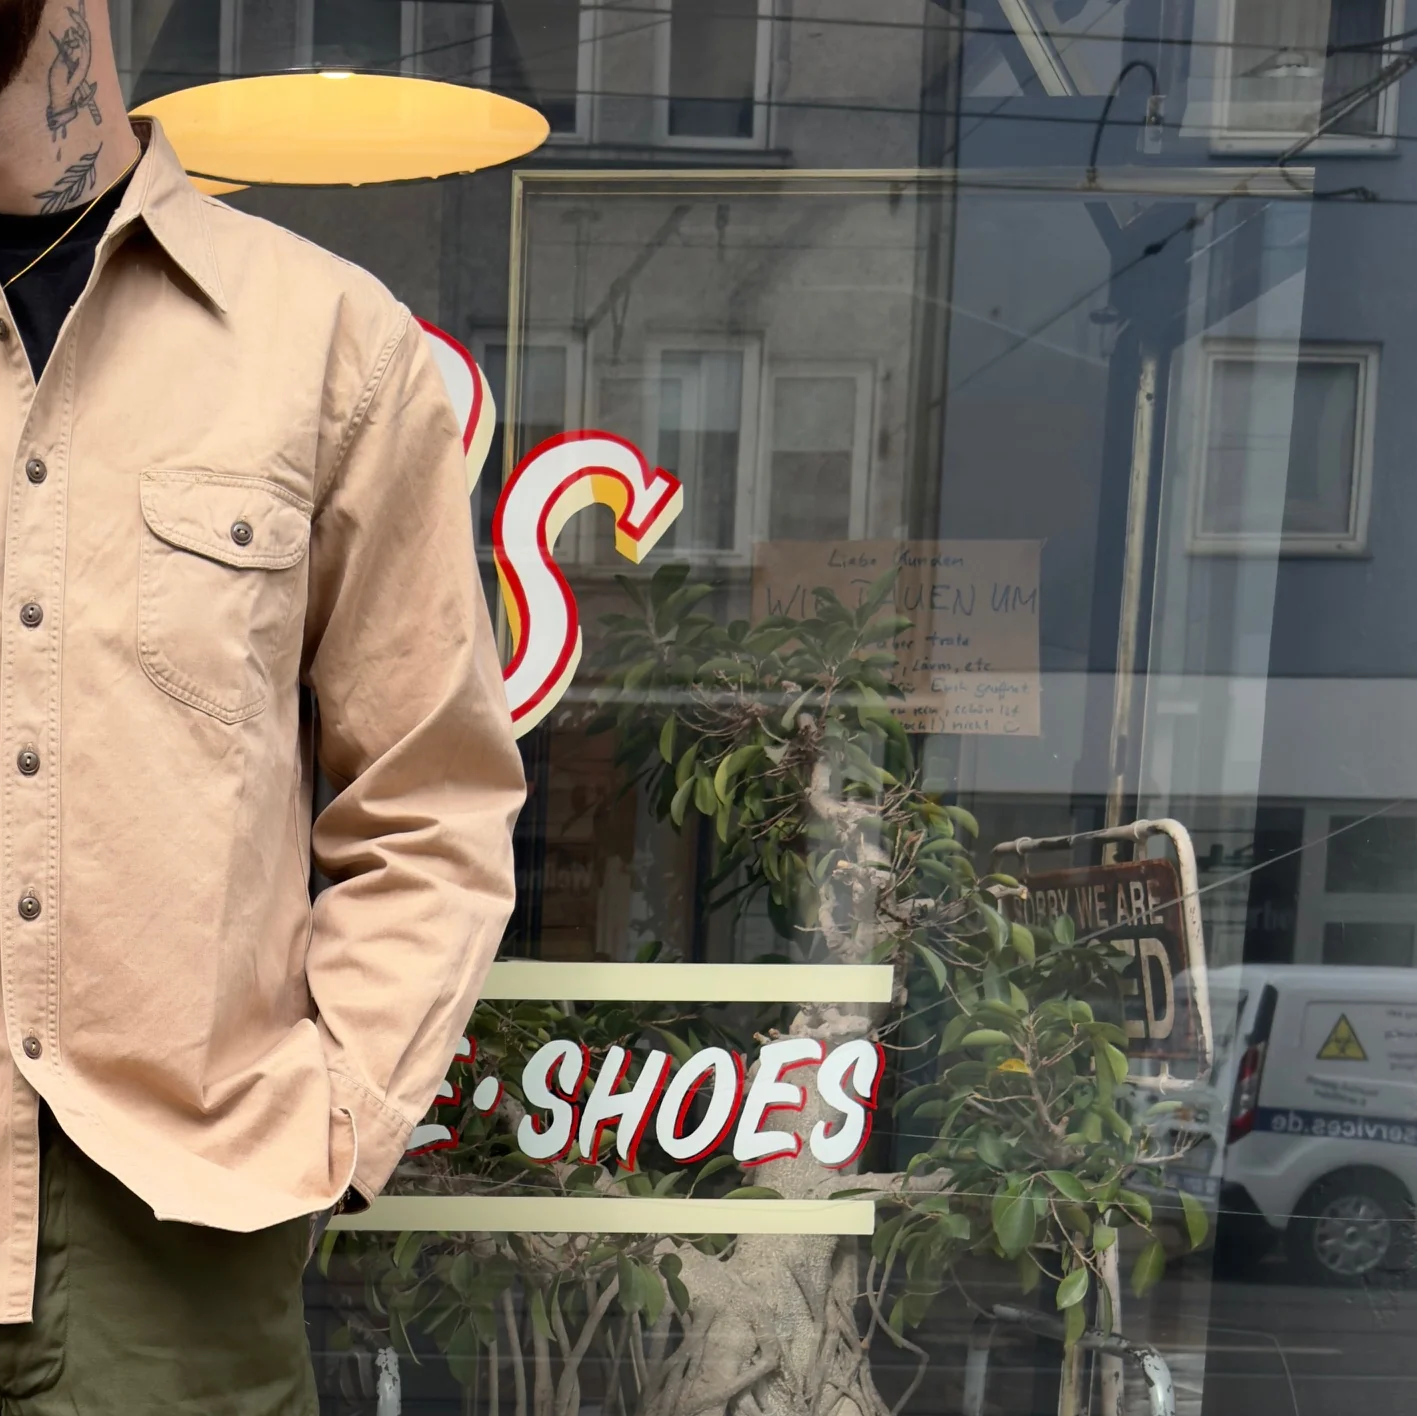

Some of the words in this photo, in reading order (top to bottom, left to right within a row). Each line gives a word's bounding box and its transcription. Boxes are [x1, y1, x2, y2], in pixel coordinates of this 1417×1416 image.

[990, 582, 1038, 615] UM
[1074, 883, 1109, 929] WE
[1116, 879, 1164, 926] ARE
[517, 1038, 884, 1171] SHOES
